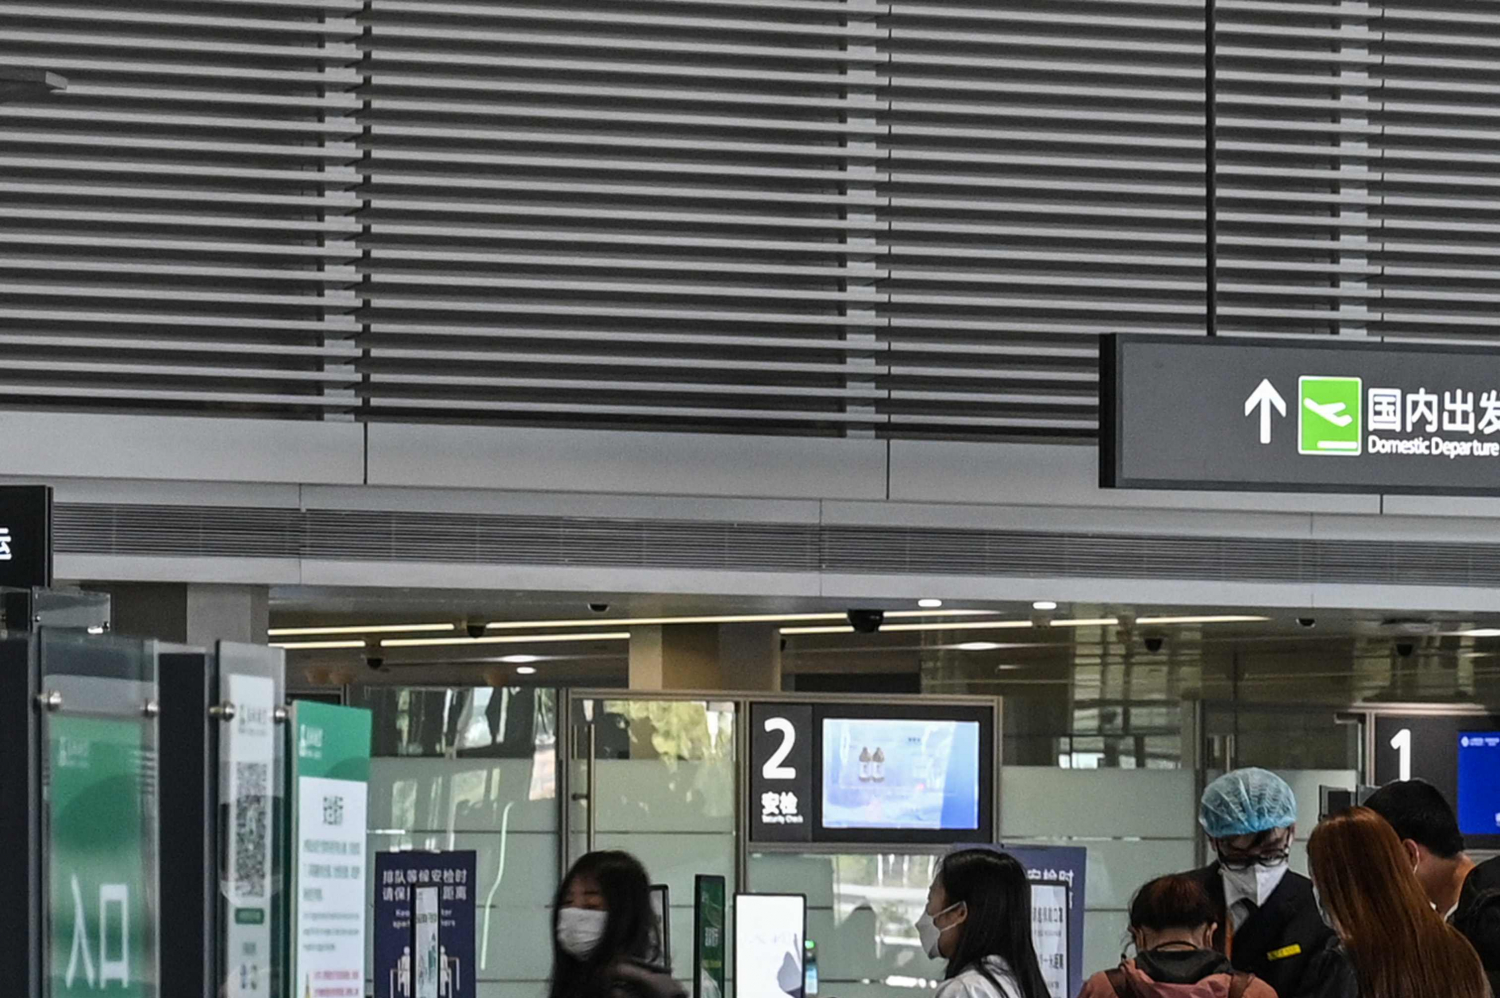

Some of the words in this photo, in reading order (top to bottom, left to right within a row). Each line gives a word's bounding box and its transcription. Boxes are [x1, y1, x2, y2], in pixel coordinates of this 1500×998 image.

[1367, 436, 1430, 456] Domestic
[1431, 437, 1500, 459] Departure
[762, 717, 796, 779] 2
[1390, 728, 1412, 782] 1
[761, 791, 799, 815] 安检
[65, 874, 129, 988] 入口
